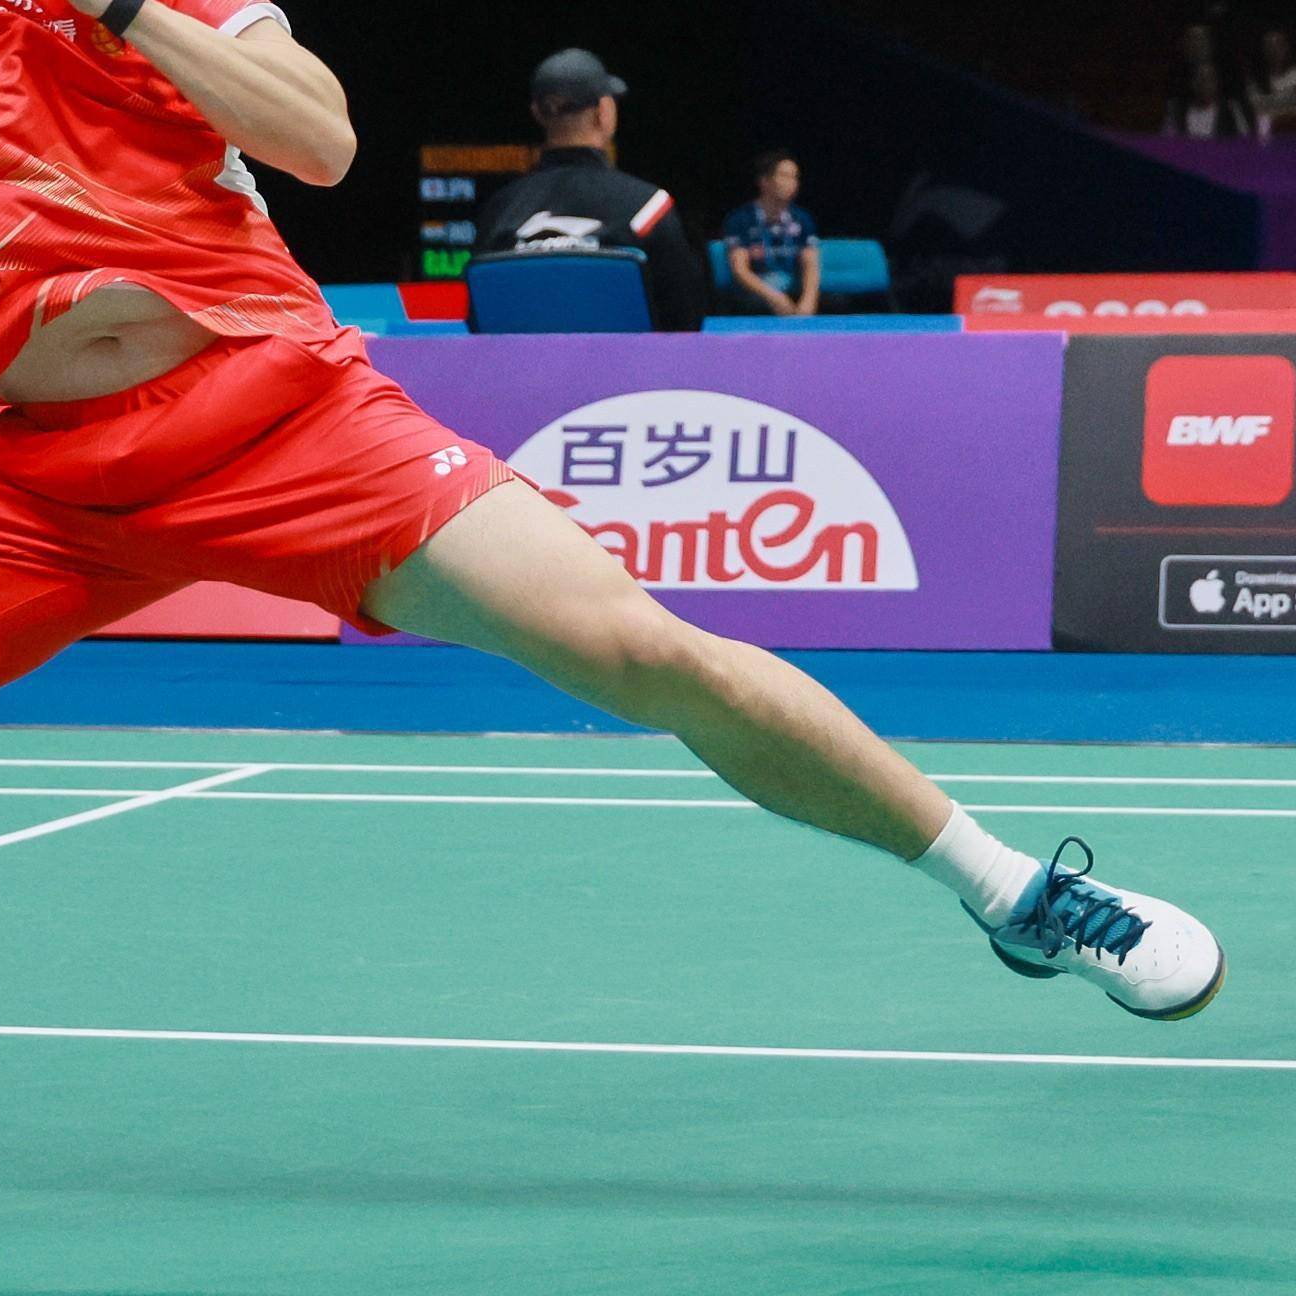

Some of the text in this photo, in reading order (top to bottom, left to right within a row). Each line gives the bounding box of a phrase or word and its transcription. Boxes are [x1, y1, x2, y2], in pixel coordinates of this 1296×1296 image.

[1167, 415, 1273, 447] BWF
[561, 422, 797, 488] 百岁山
[1232, 587, 1291, 618] App
